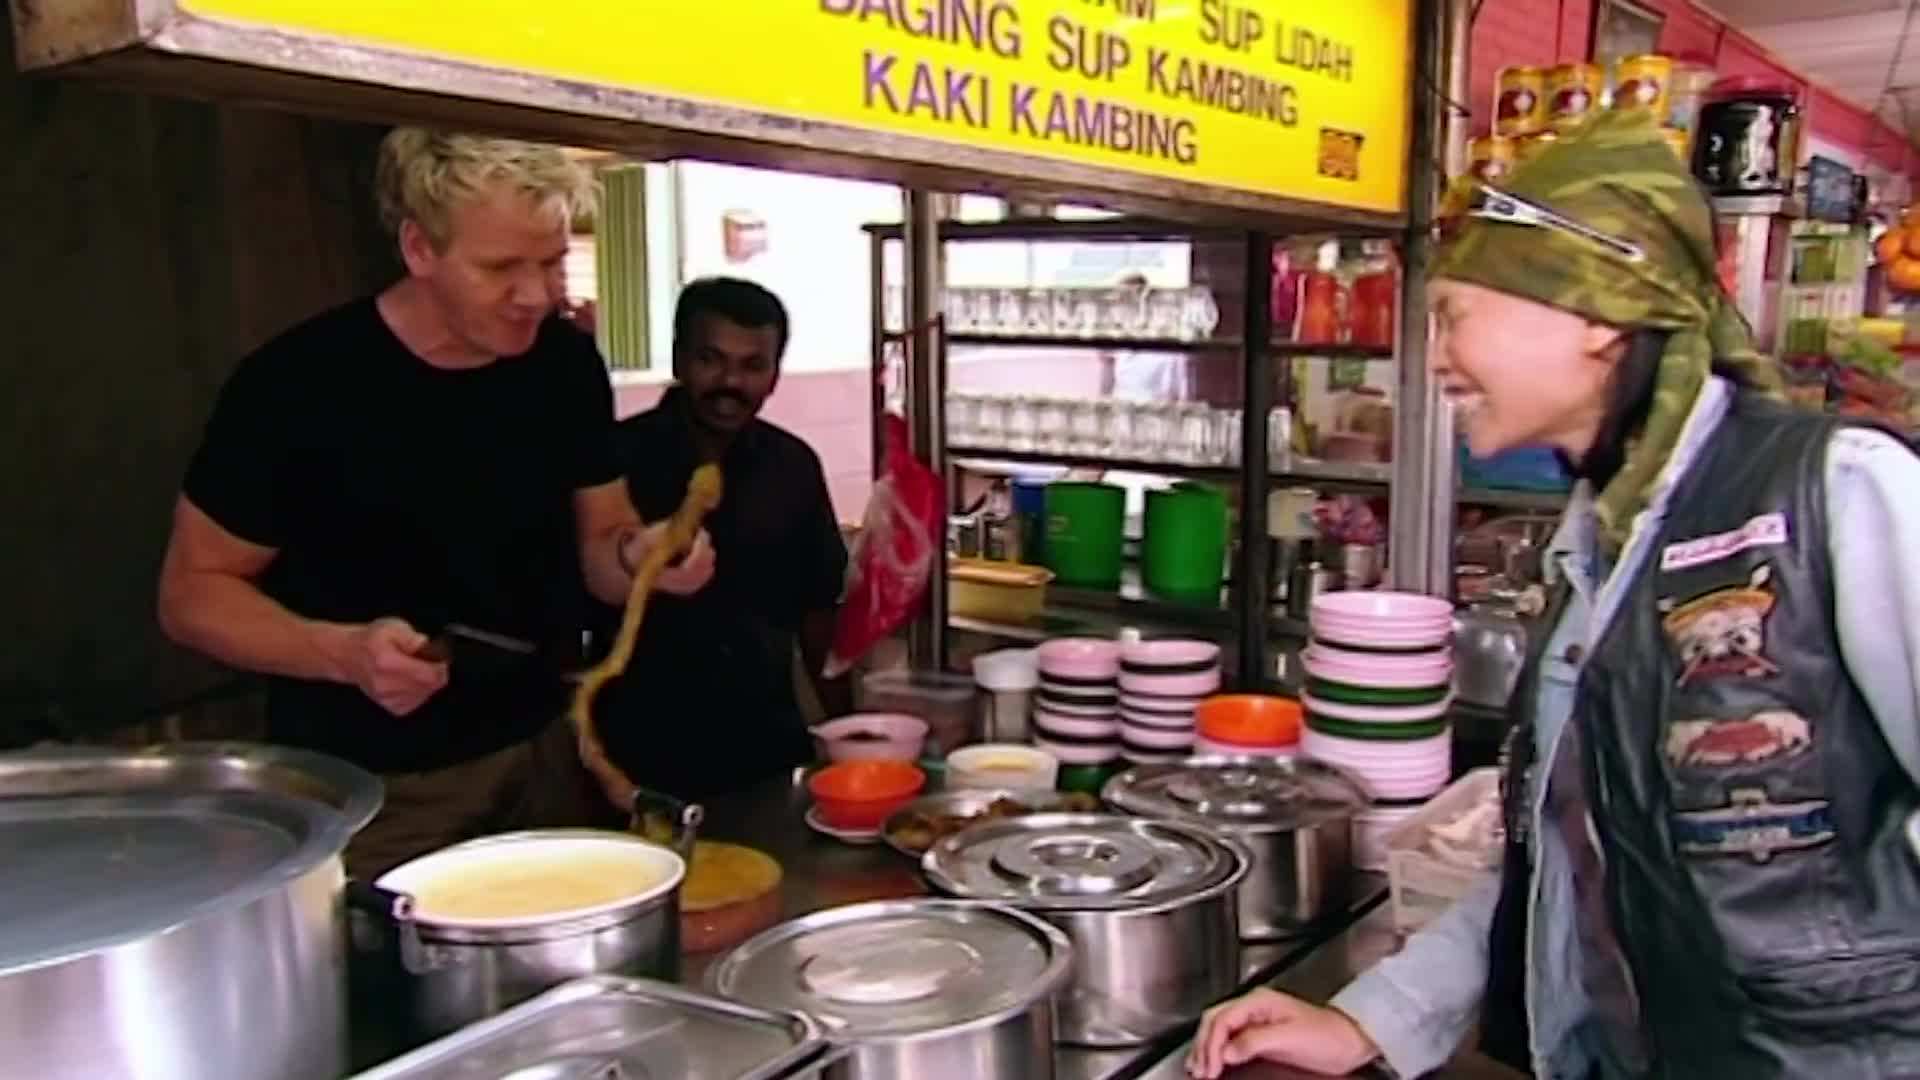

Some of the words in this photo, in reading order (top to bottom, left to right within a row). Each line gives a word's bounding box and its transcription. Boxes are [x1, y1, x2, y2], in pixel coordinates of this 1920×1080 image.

[819, 0, 1021, 59] AGING
[1047, 15, 1131, 81] SUP
[1147, 47, 1298, 127] KAMBING
[1199, 0, 1263, 53] SUP
[1275, 21, 1353, 83] LIDAH
[864, 51, 989, 129] KAKI
[1010, 83, 1197, 165] KAMBING
